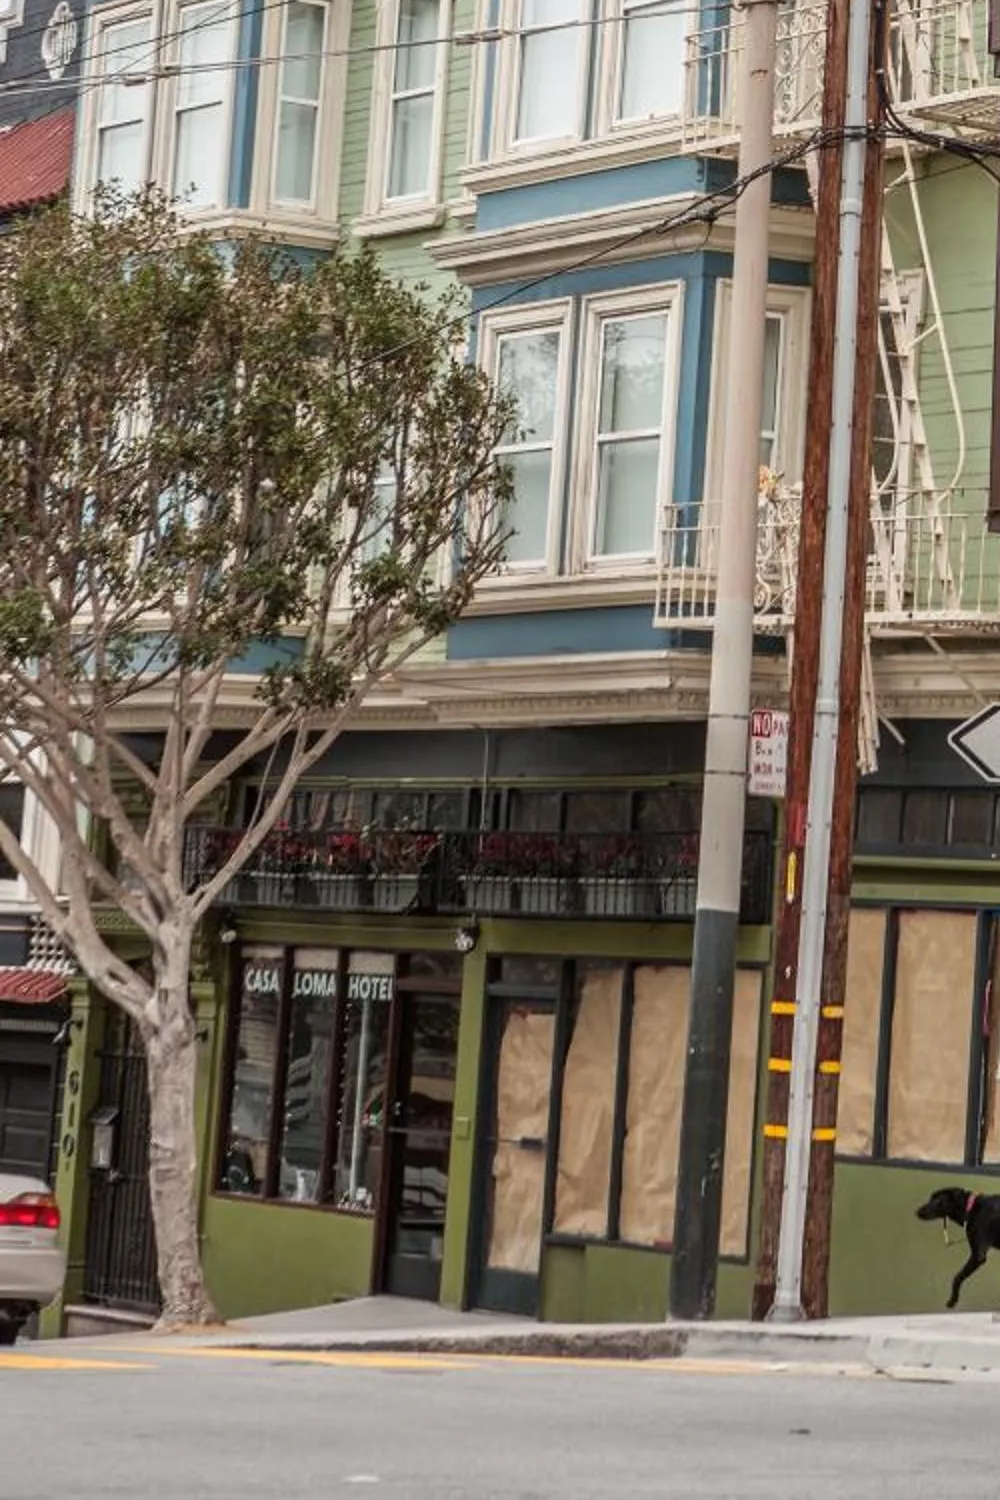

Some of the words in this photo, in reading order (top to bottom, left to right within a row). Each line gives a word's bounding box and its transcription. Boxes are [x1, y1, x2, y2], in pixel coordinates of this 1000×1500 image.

[752, 712, 771, 736] NO
[244, 968, 280, 993] CASA
[293, 972, 336, 998] LOMA
